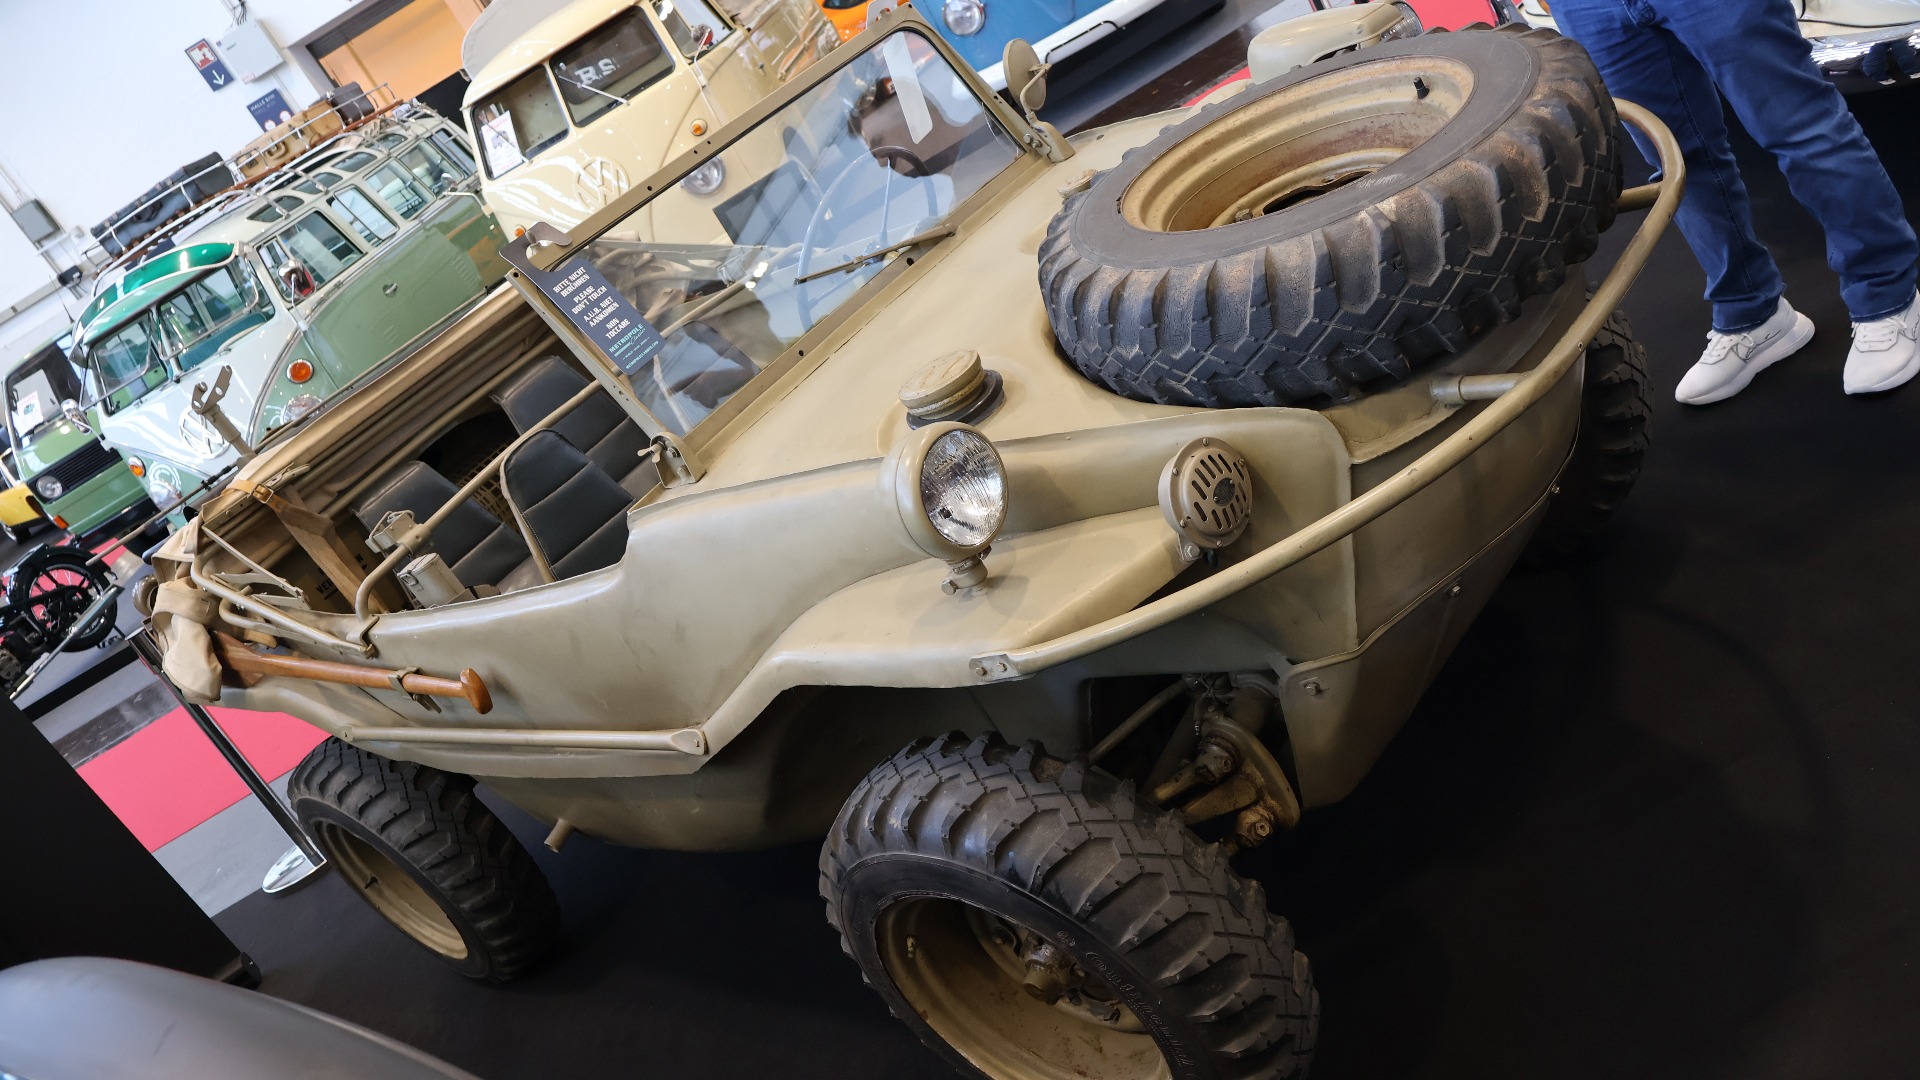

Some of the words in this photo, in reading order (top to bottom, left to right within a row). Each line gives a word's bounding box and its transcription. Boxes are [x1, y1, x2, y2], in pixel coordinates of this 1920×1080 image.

[553, 278, 571, 294] BITTE
[568, 266, 587, 282] NICHT
[560, 273, 590, 298] BERÜHREN
[571, 298, 590, 315] DON'T
[588, 285, 608, 302] TOUCH
[573, 285, 596, 304] PLEASE
[599, 295, 614, 309] NIET
[588, 301, 620, 328] AANKOMEN
[605, 317, 620, 330] NON
[605, 318, 631, 340] TOCCARE
[608, 323, 644, 353] METROPOLE
